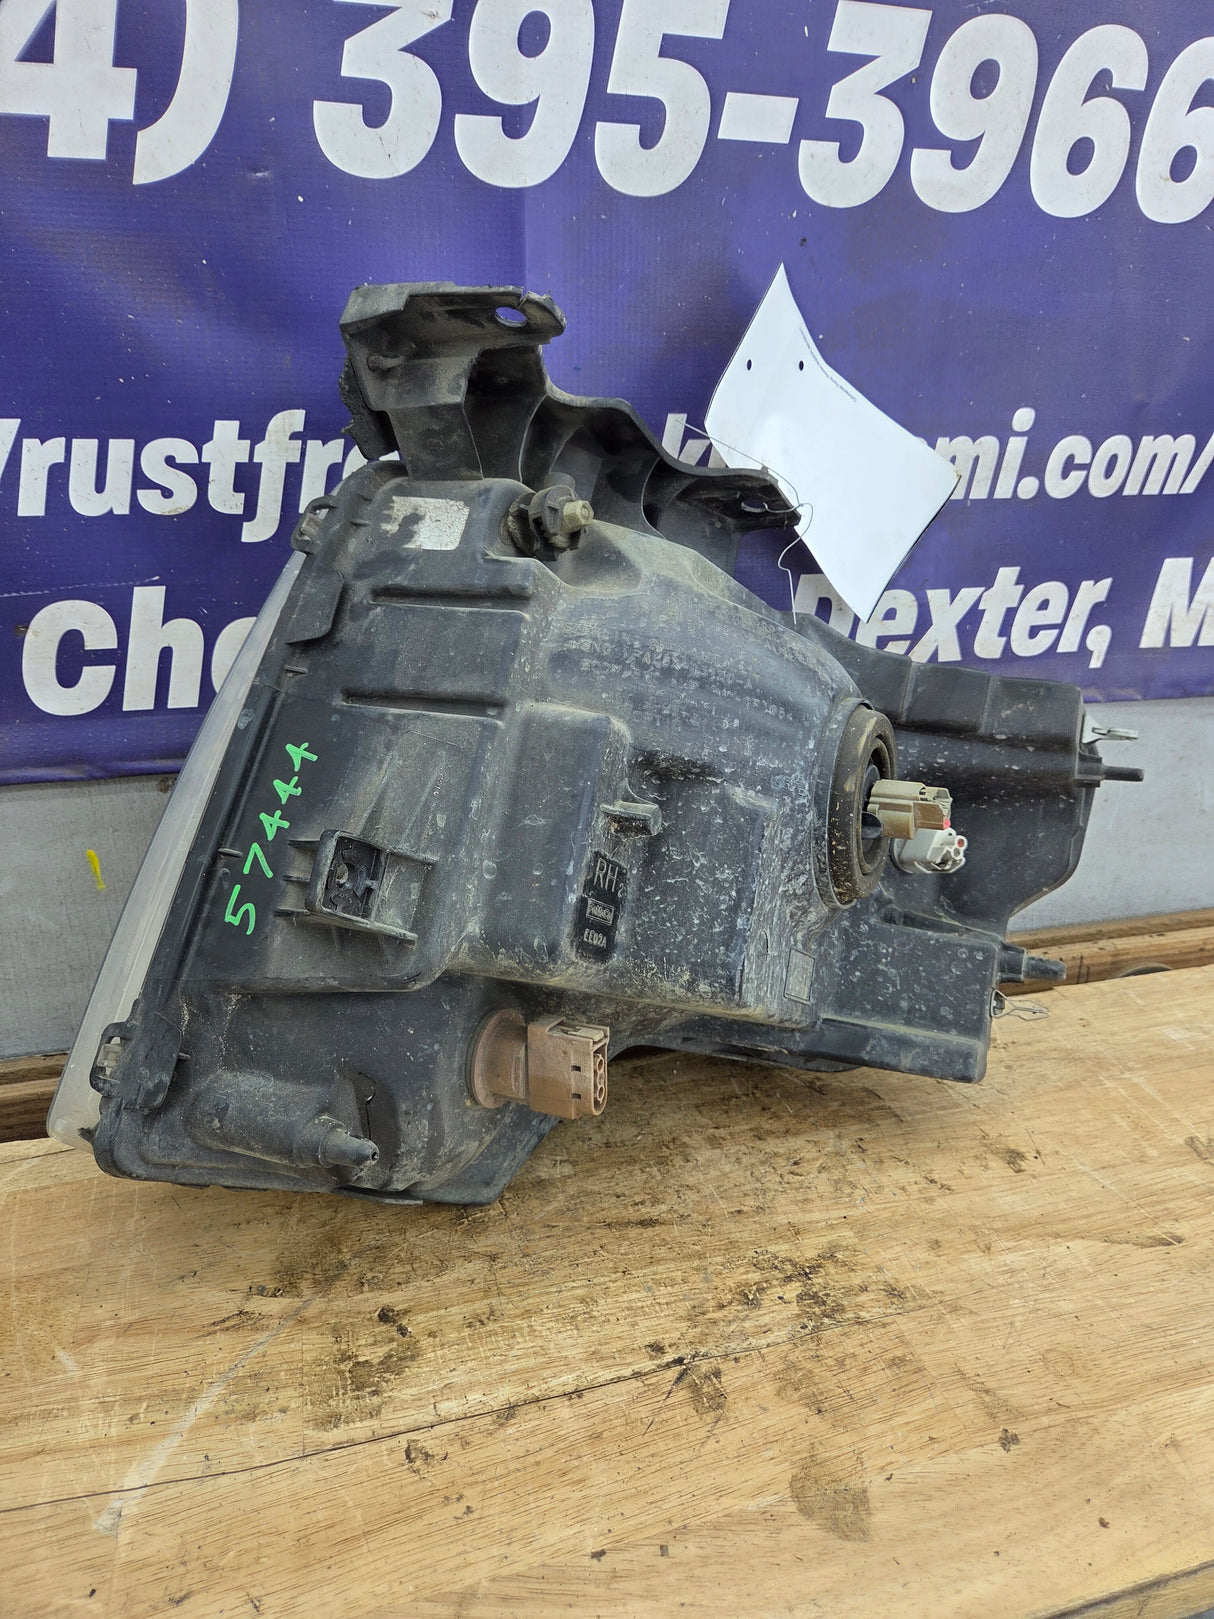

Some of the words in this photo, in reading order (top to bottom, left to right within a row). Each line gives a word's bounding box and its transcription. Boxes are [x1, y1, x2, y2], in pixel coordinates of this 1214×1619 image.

[0, 0, 239, 185] 4)
[313, 0, 1214, 224] 395-3966
[915, 407, 1214, 500] mi.com/
[224, 742, 319, 935] 57444
[593, 857, 619, 893] RH
